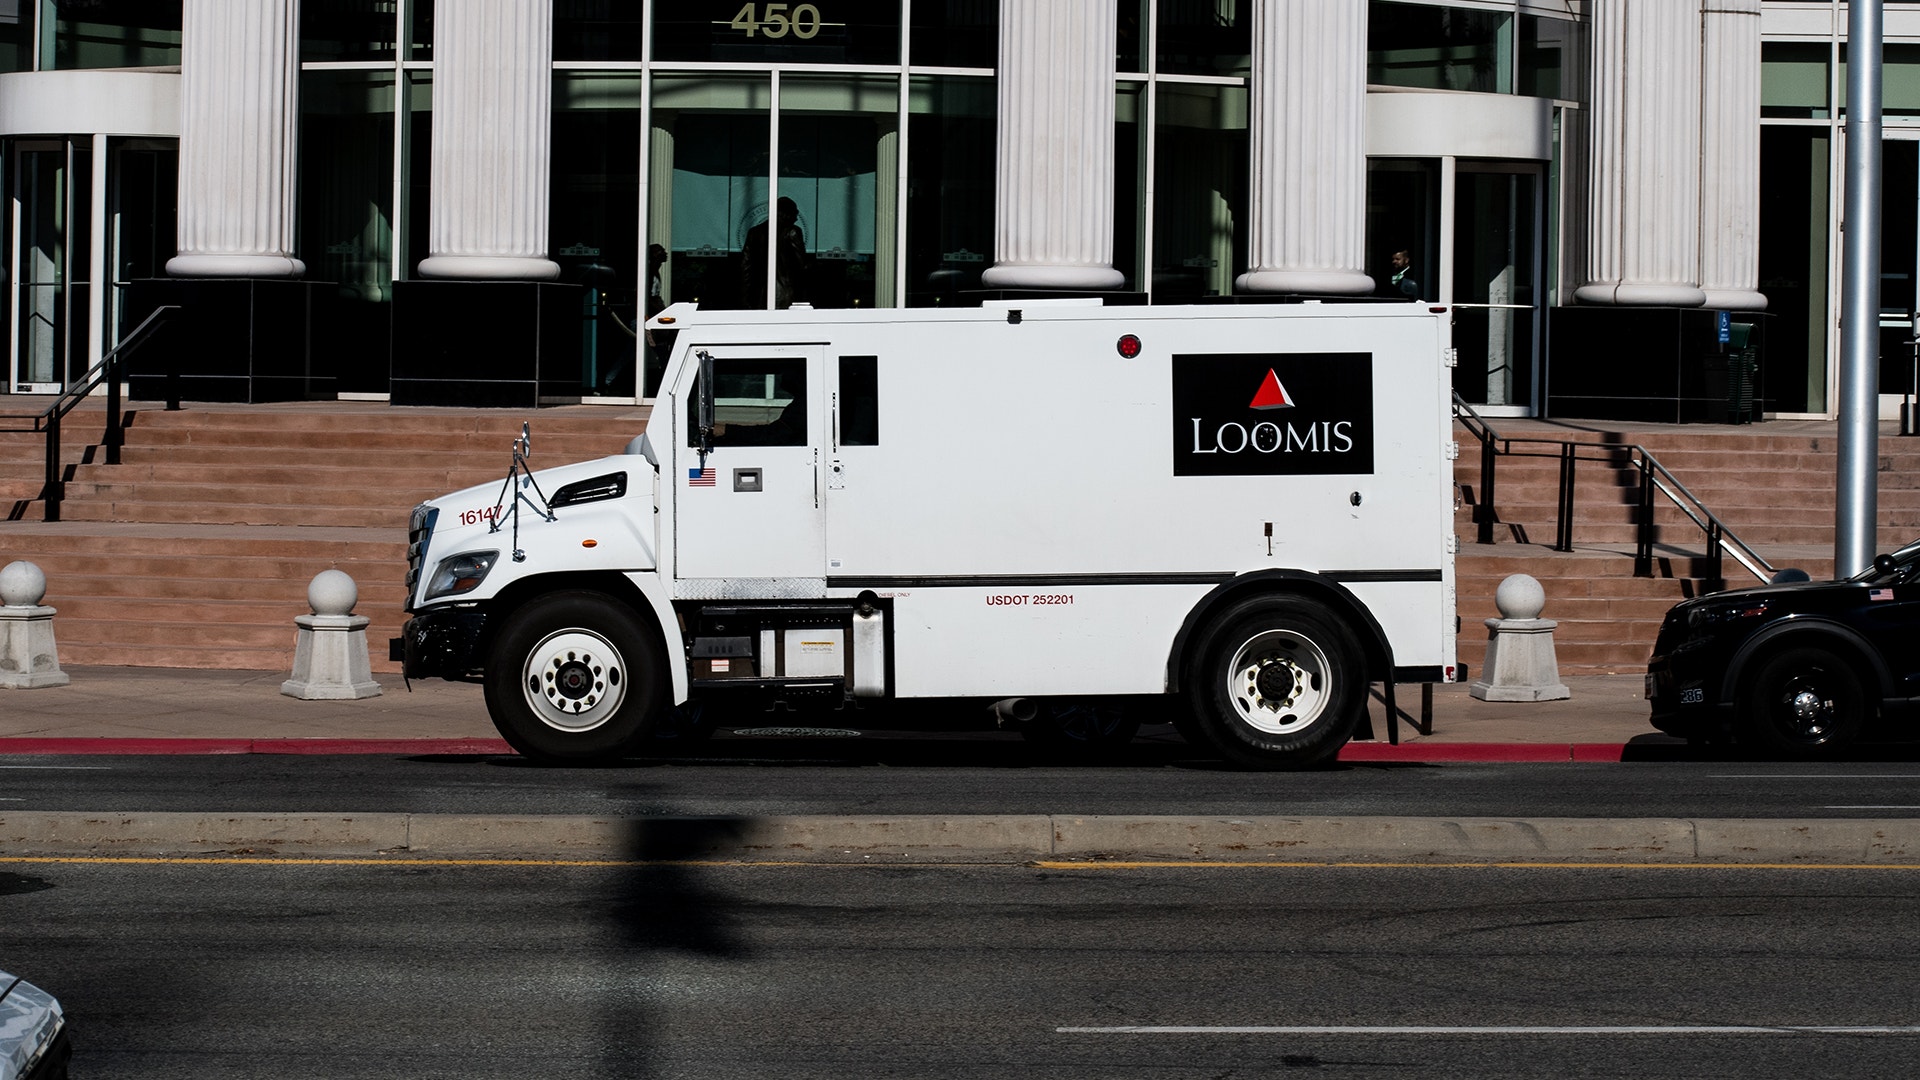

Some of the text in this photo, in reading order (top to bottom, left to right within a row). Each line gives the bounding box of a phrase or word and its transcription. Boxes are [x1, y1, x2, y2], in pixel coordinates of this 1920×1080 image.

[731, 2, 820, 39] 450
[1191, 418, 1353, 454] LOOMIS
[459, 505, 503, 526] 16147
[986, 594, 1074, 606] USDOT 252201
